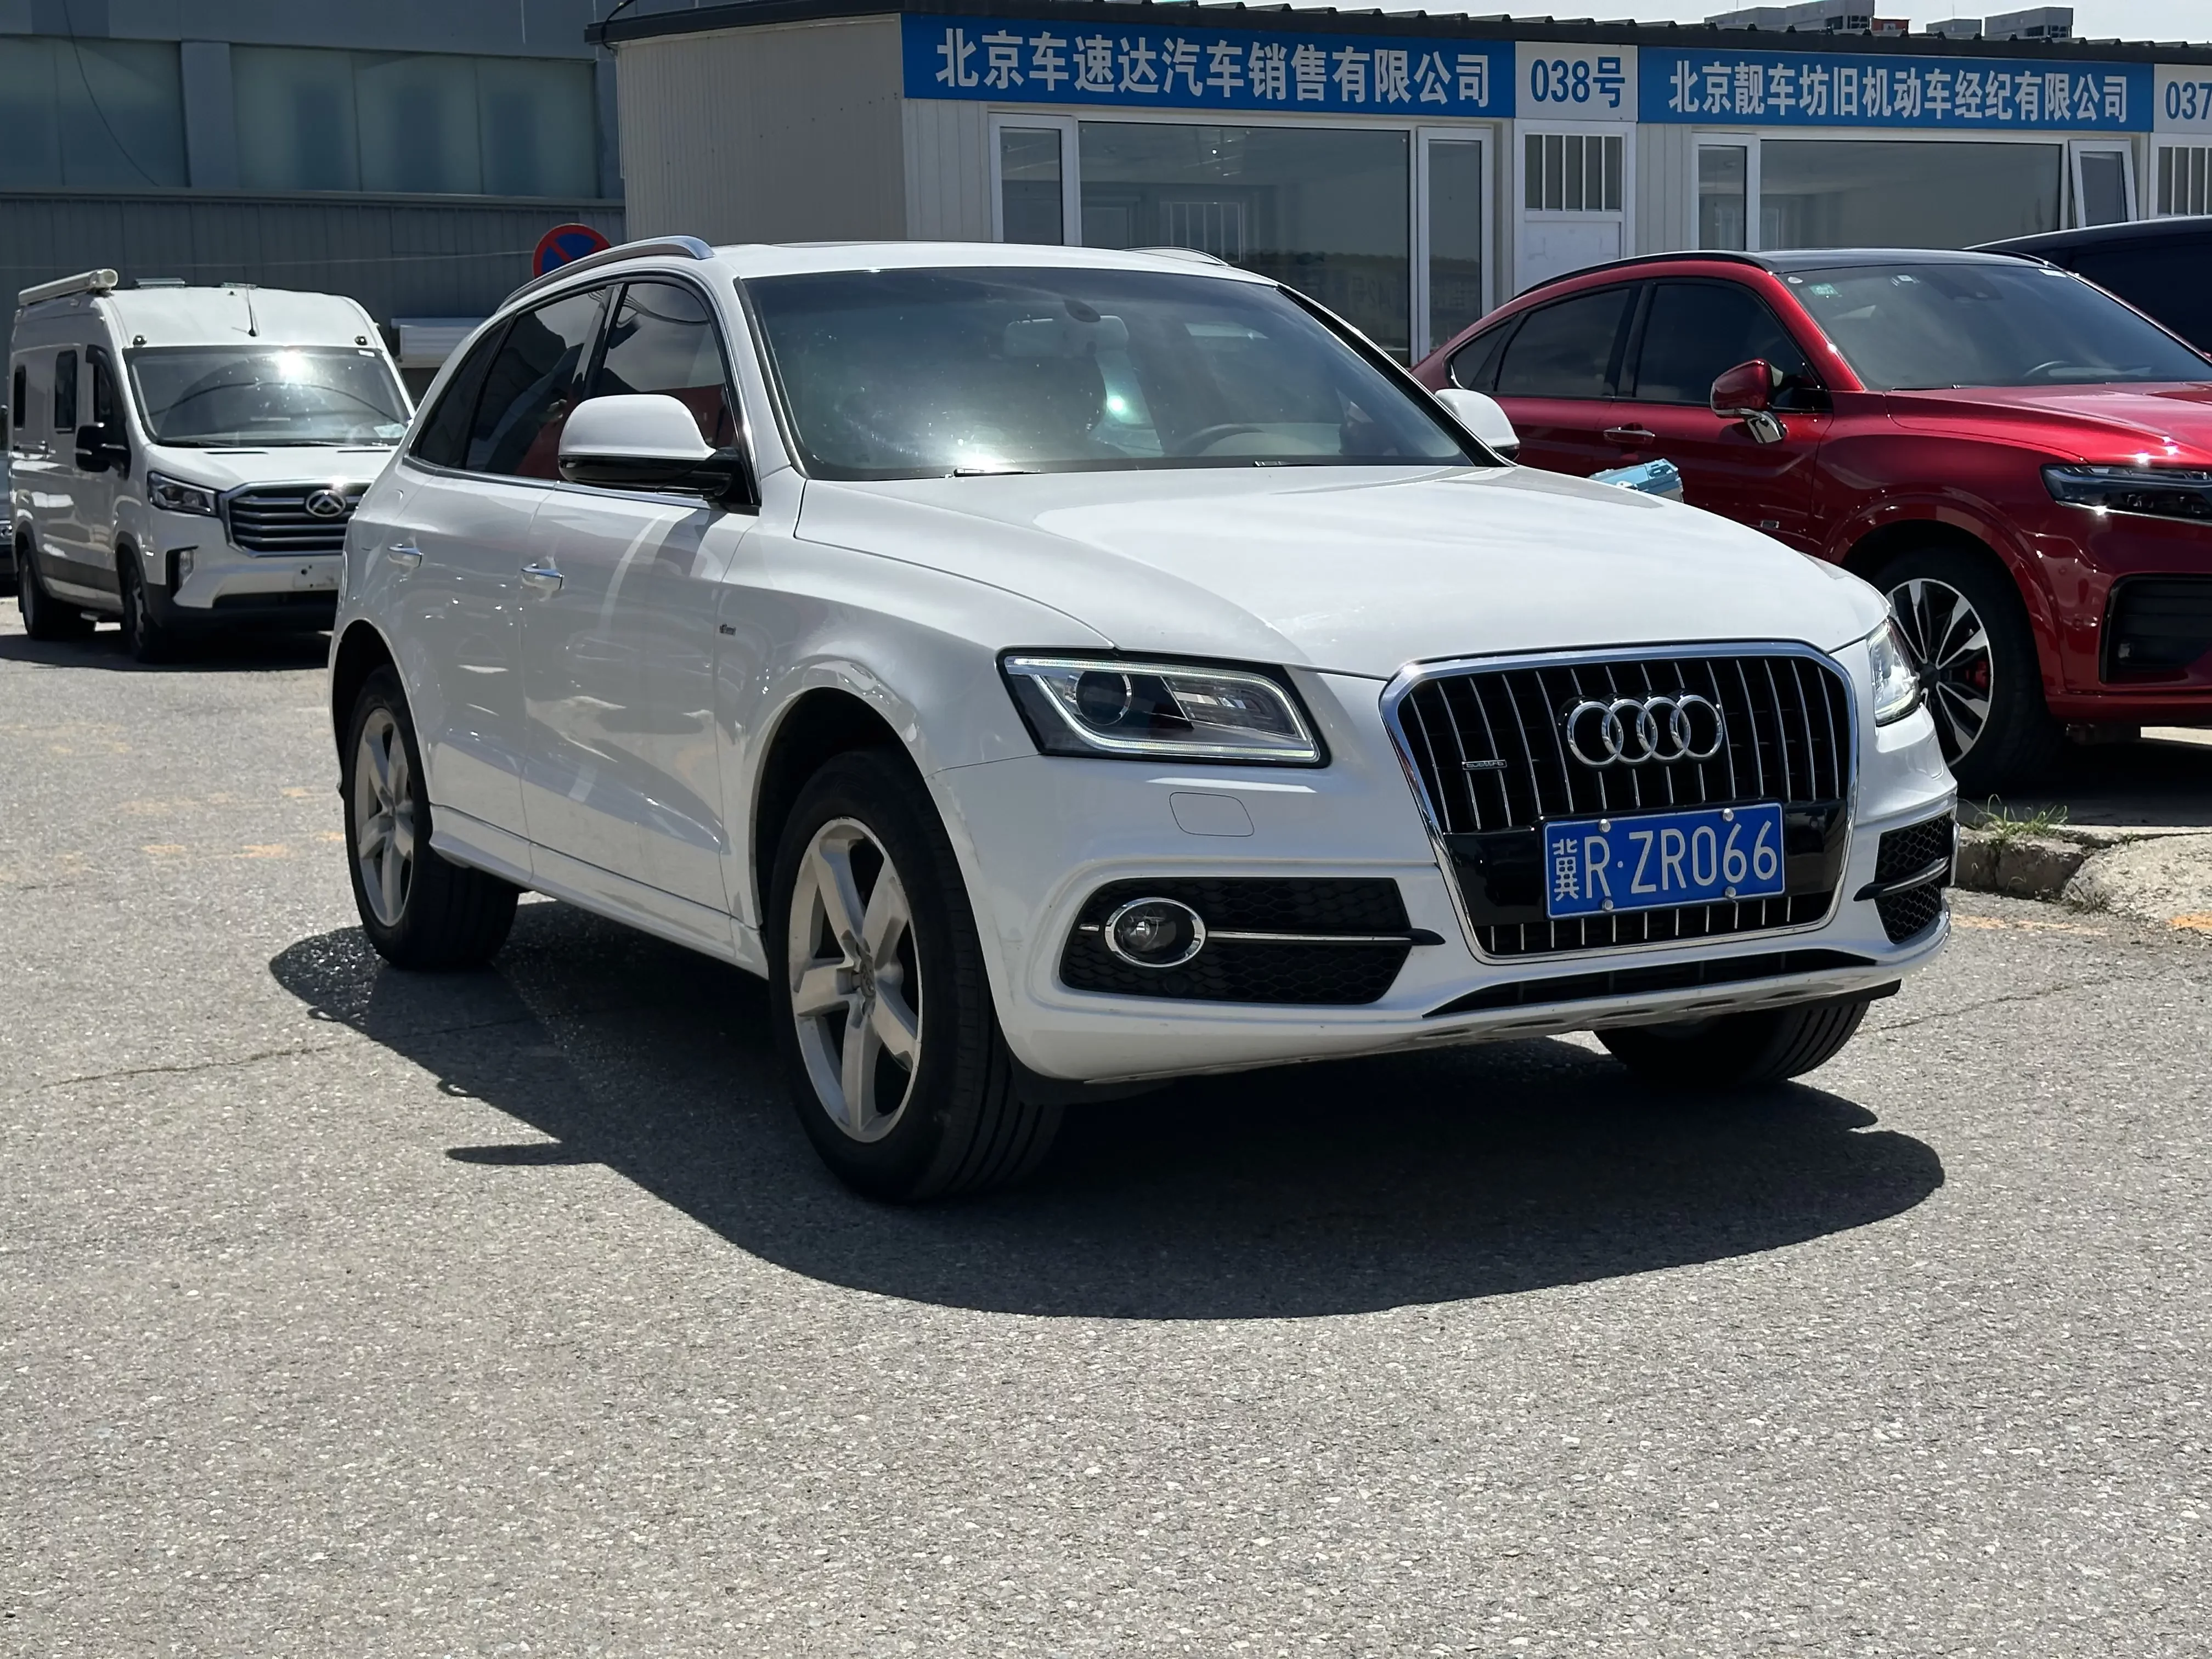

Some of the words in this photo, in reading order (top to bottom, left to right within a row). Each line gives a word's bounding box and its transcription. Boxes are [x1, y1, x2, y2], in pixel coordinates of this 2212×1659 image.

[935, 28, 1489, 108] 北京车速达汽车销售有限公司
[1531, 57, 1625, 108] 038号
[1668, 59, 2128, 123] 北京靓车坊旧机动车经纪有限公司
[2165, 81, 2212, 120] 037
